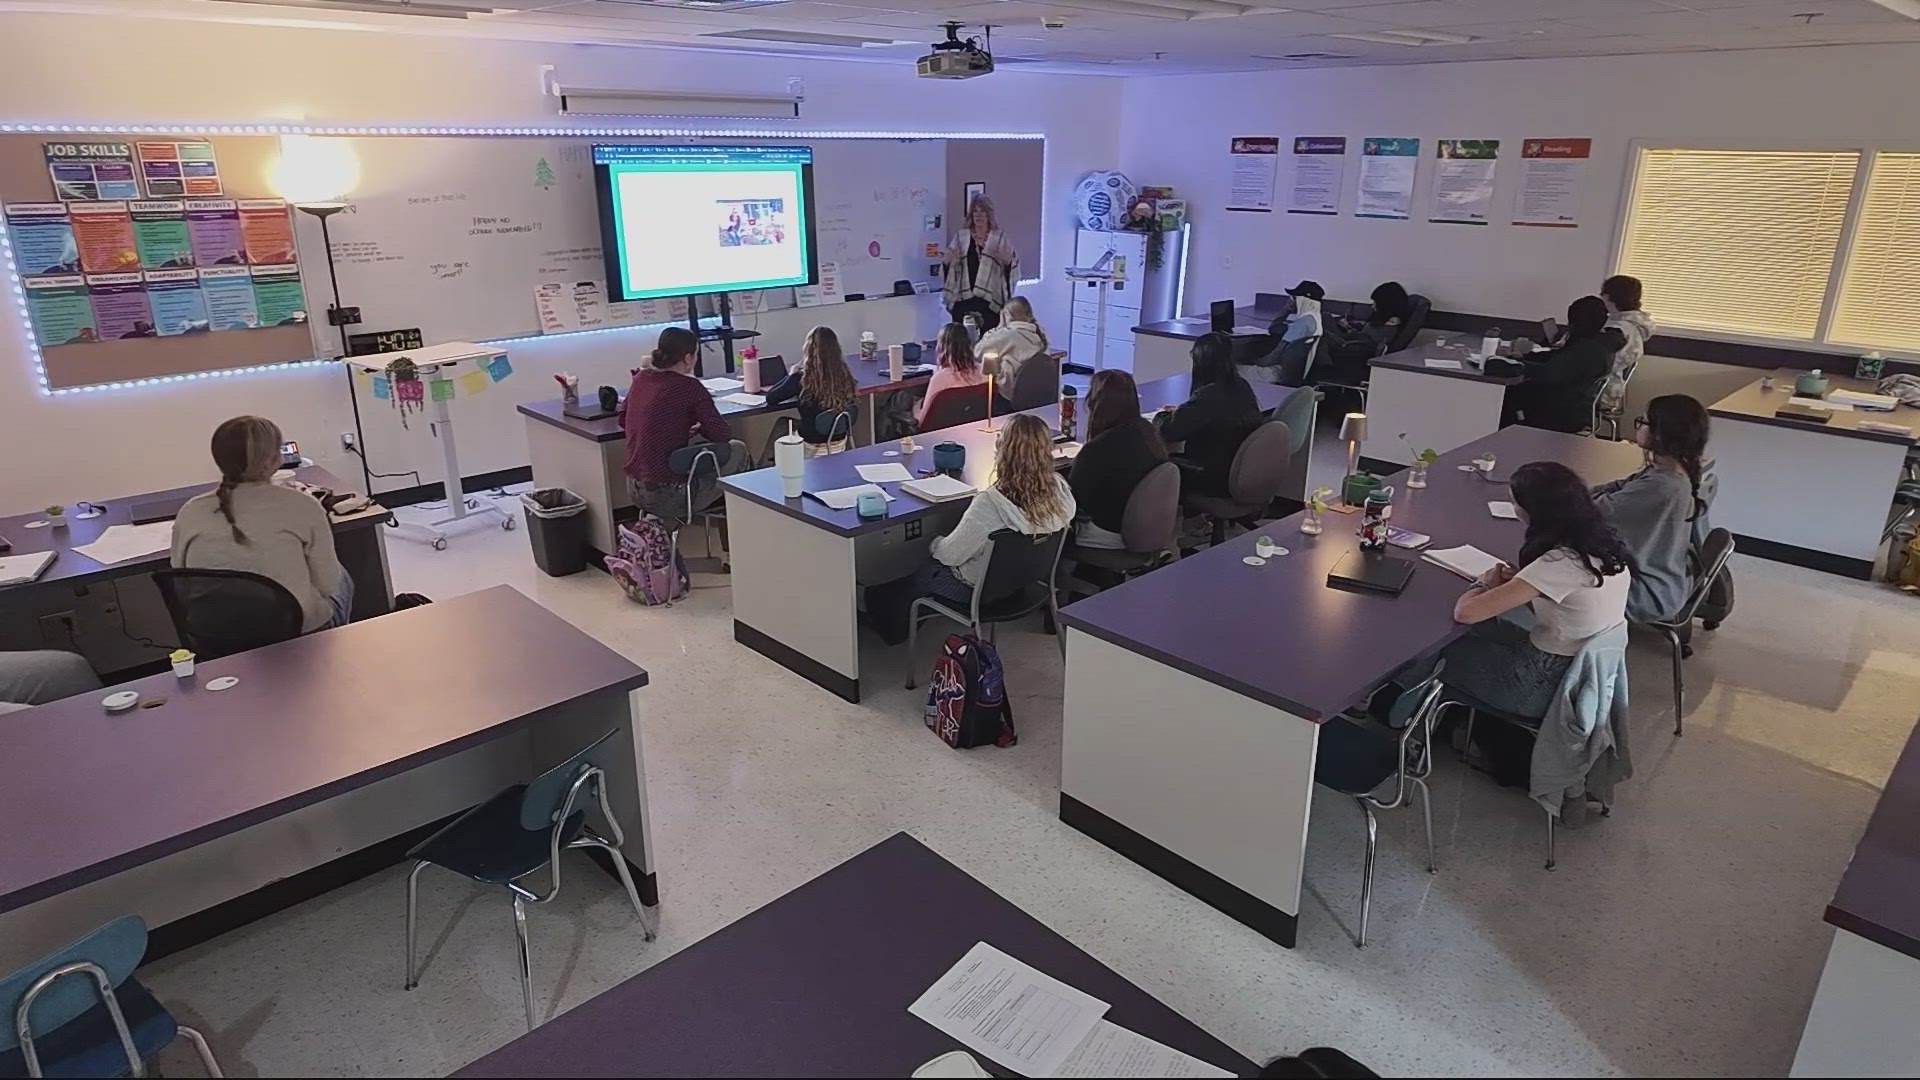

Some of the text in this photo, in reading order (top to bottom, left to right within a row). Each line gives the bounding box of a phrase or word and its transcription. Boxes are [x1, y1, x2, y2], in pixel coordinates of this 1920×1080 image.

[47, 144, 129, 156] JOB SKILLS
[149, 271, 193, 279] ADAPTABILITY
[203, 268, 245, 276] PUNCTUALITY
